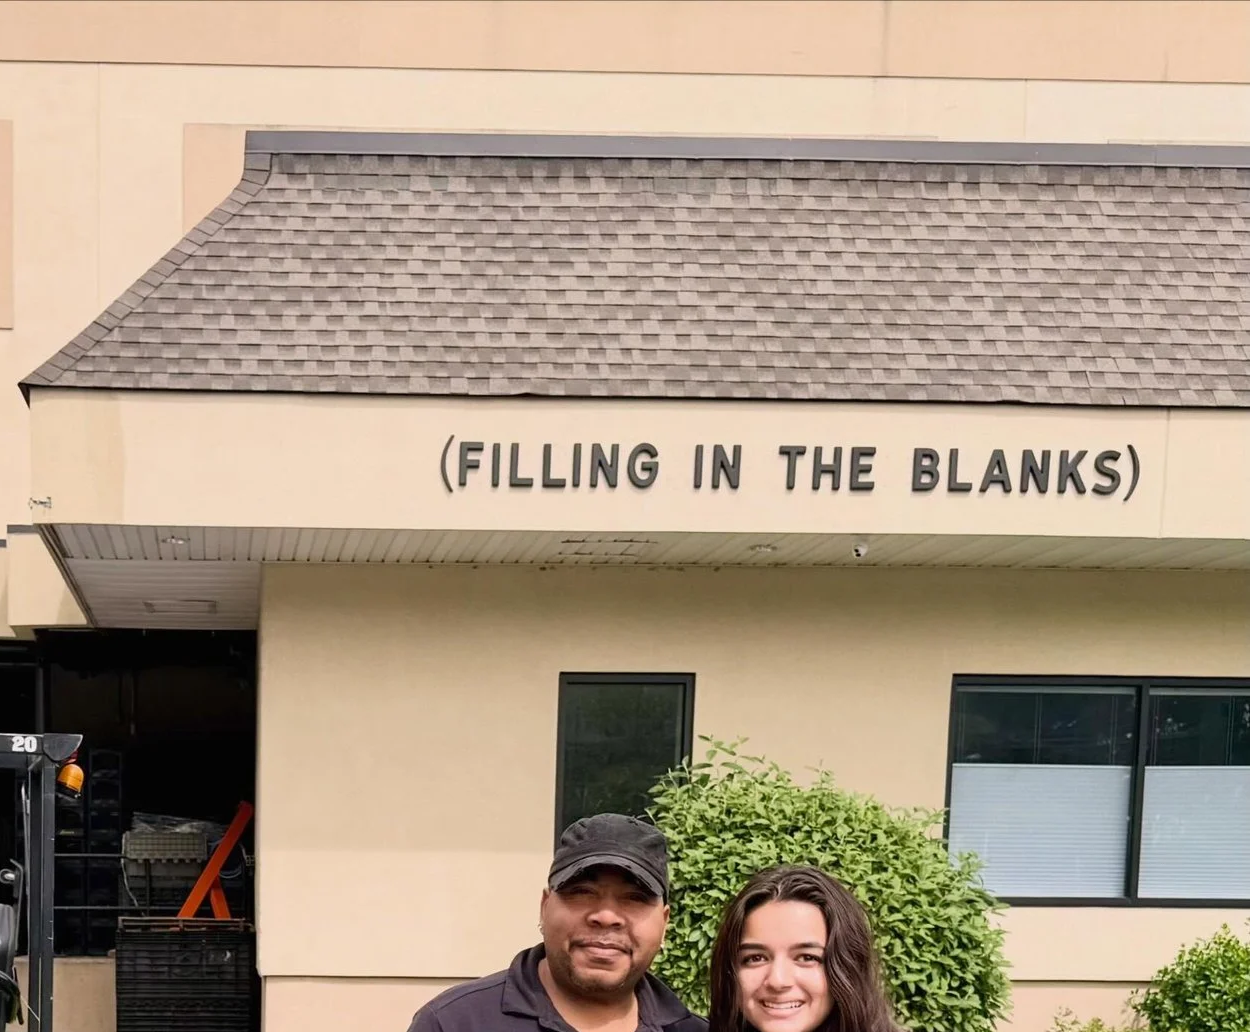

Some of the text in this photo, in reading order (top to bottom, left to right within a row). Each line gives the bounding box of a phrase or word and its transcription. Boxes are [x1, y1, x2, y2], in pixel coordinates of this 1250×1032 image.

[693, 444, 743, 490] IN
[779, 444, 877, 492] THE
[11, 735, 37, 753] 20
